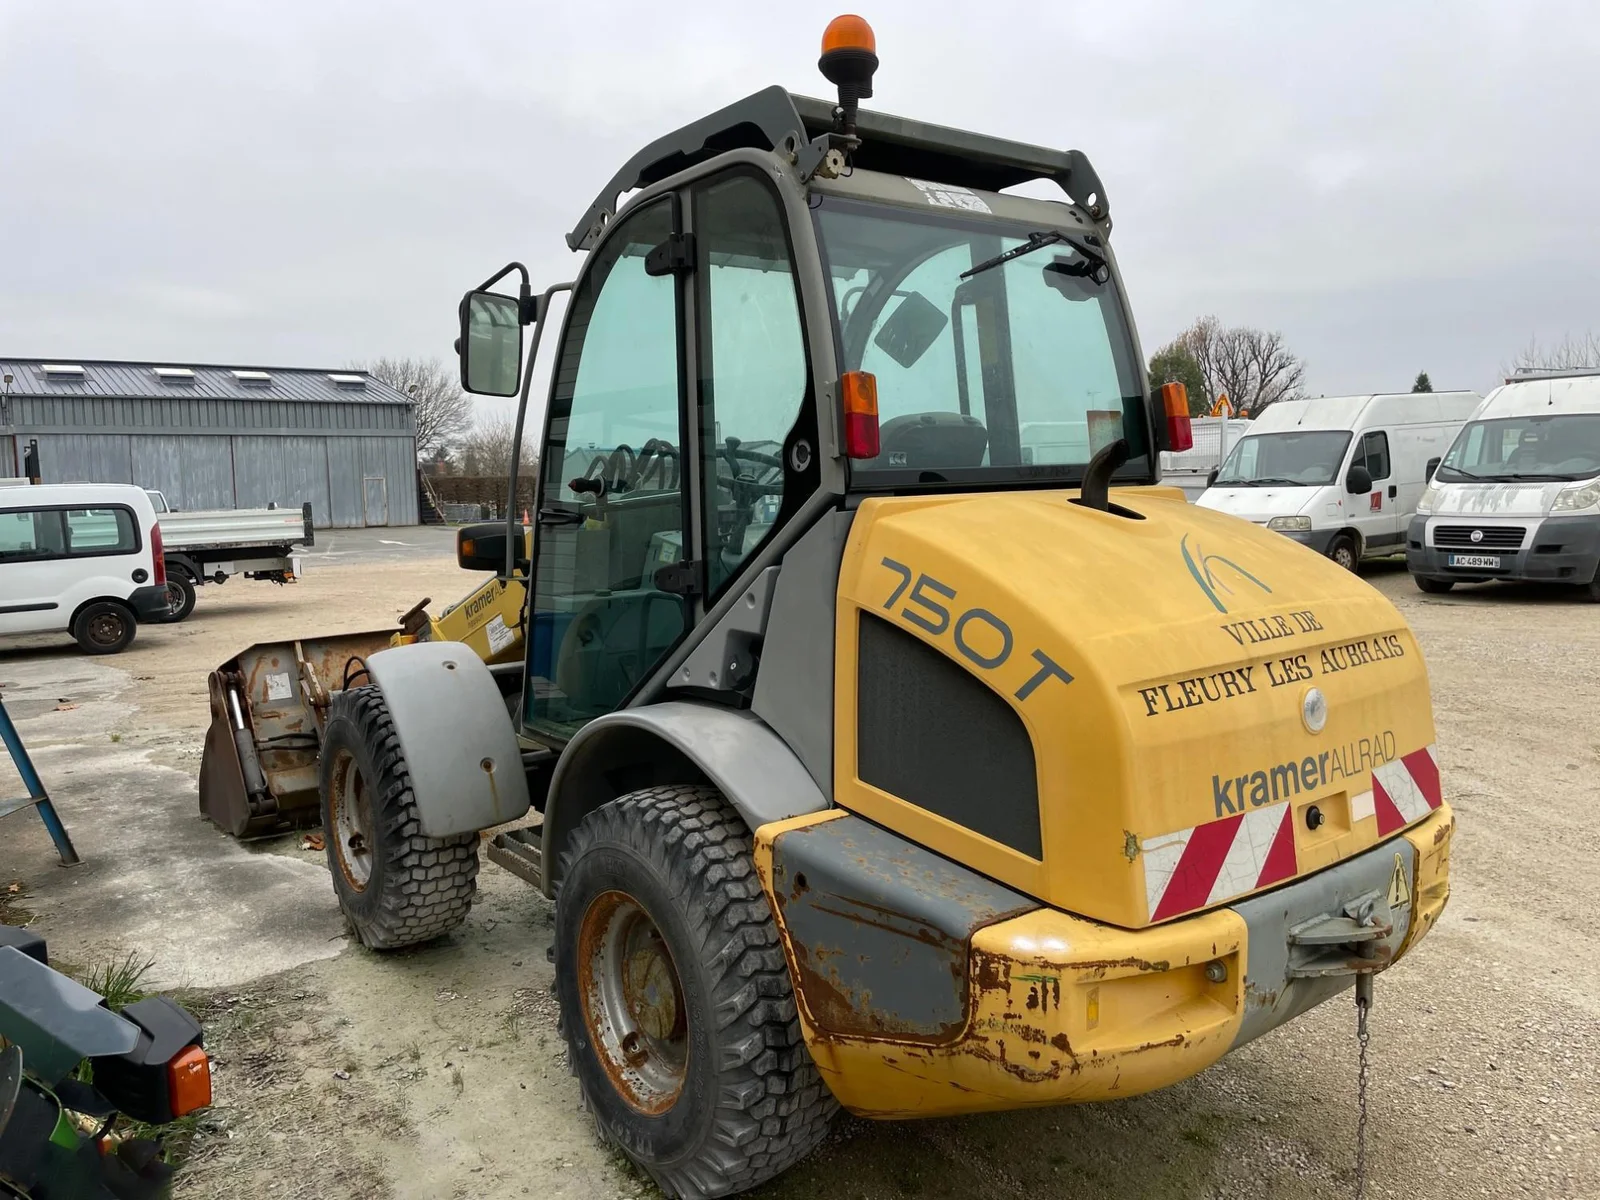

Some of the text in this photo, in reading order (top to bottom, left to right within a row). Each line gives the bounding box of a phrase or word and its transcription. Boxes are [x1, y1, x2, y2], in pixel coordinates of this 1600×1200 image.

[881, 556, 1075, 701] 750 T
[1221, 610, 1324, 645] VILLE DE
[1138, 666, 1257, 716] FLEURY
[1264, 654, 1313, 687] LES
[1320, 634, 1405, 674] AUBRAIS
